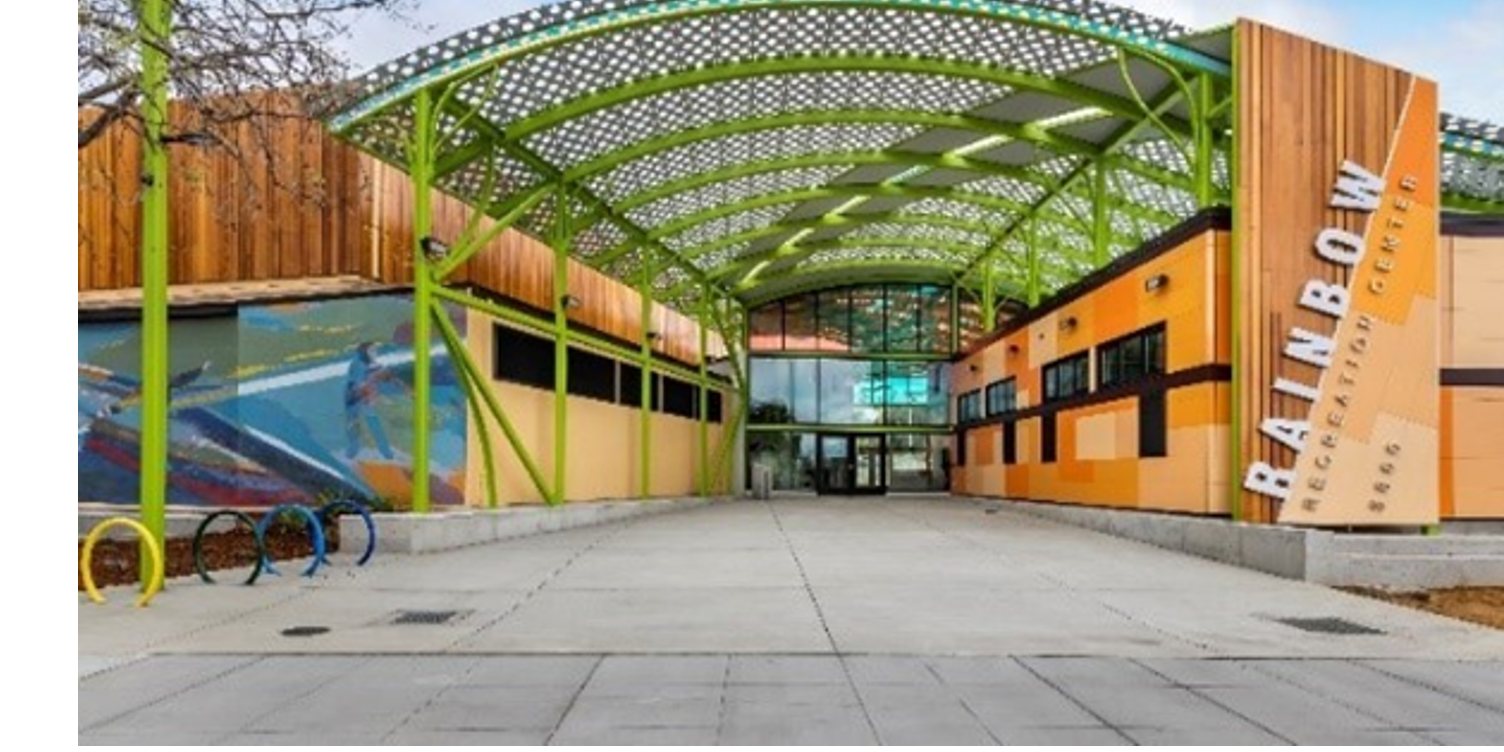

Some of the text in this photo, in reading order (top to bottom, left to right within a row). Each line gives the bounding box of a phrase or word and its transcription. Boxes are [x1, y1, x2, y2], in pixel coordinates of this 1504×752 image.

[1243, 160, 1386, 500] RAINBOW
[1301, 174, 1419, 513] RECREATION CENTER
